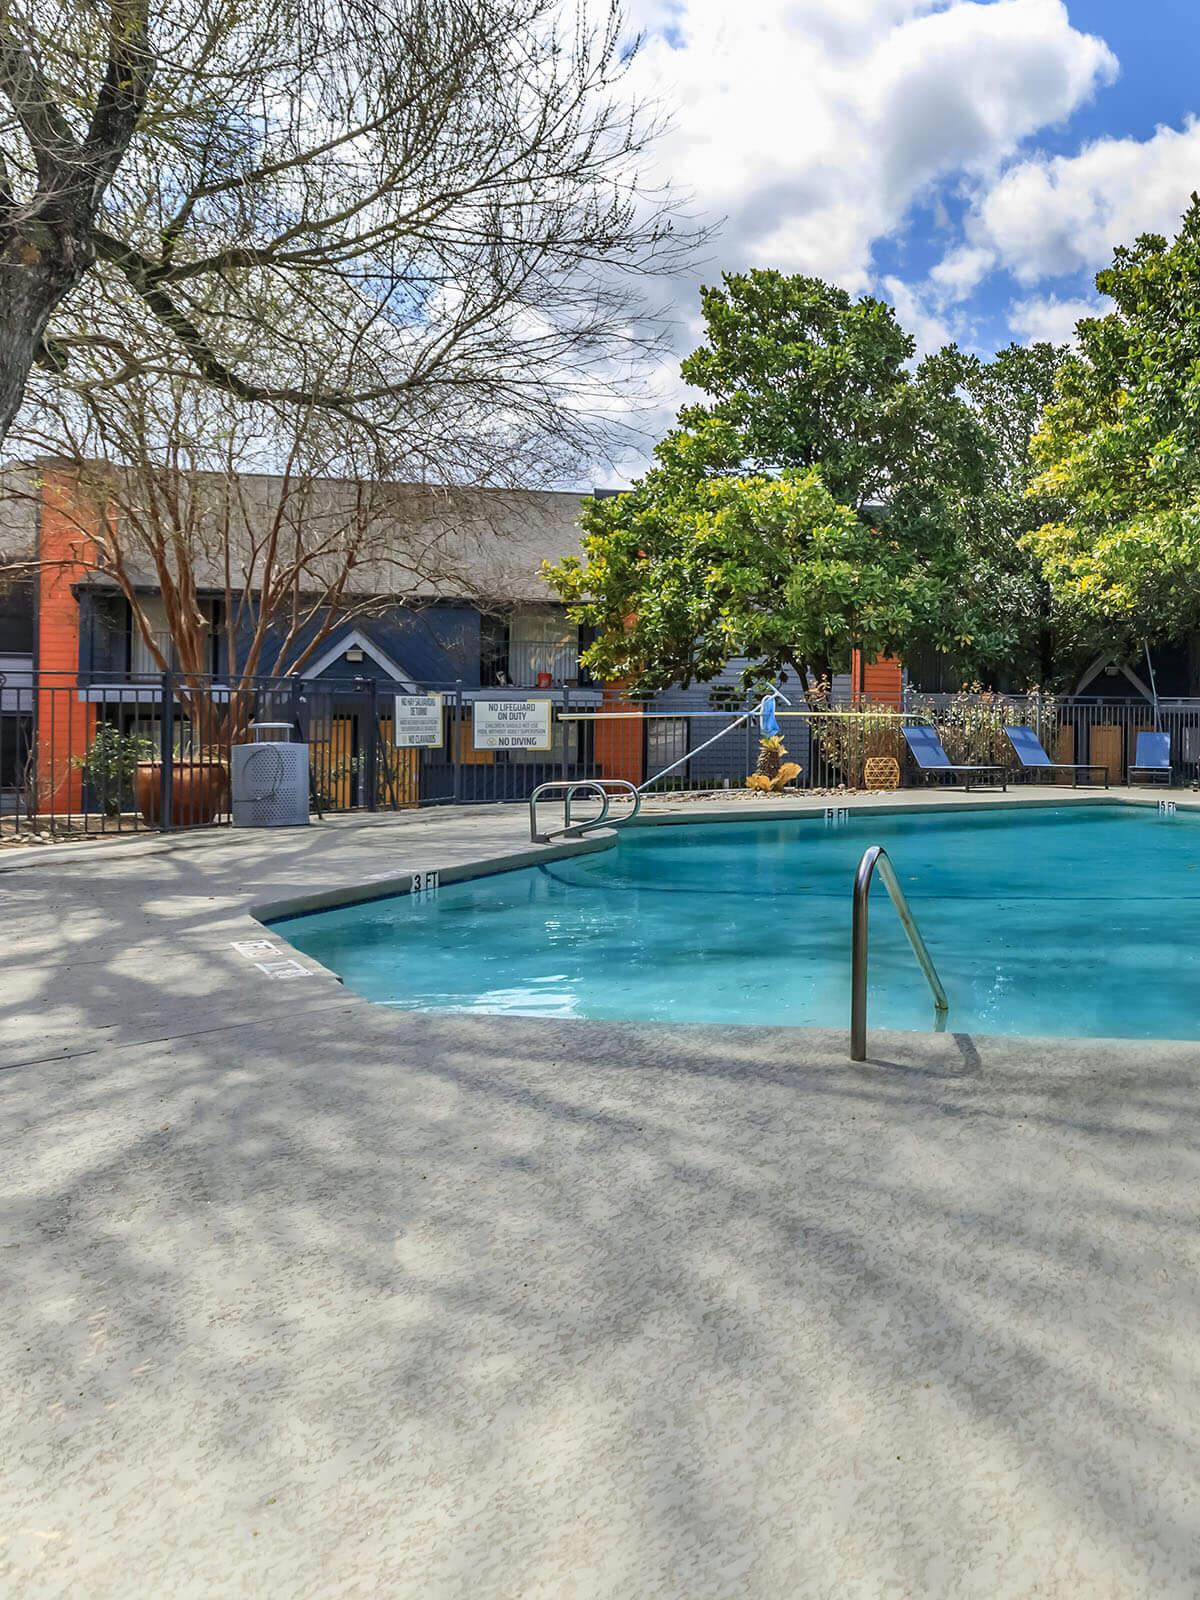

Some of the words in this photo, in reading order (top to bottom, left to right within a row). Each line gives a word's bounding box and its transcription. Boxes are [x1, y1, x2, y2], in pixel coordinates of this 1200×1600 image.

[488, 703, 498, 711] NO
[500, 703, 535, 711] LIFEGUARD
[498, 712, 507, 720] ON
[509, 712, 527, 720] DUTY
[499, 737, 509, 745] NO
[511, 737, 537, 745] DIVING
[827, 808, 833, 818] 5
[838, 807, 848, 819] FT
[414, 874, 421, 890] 3
[426, 871, 438, 888] FT
